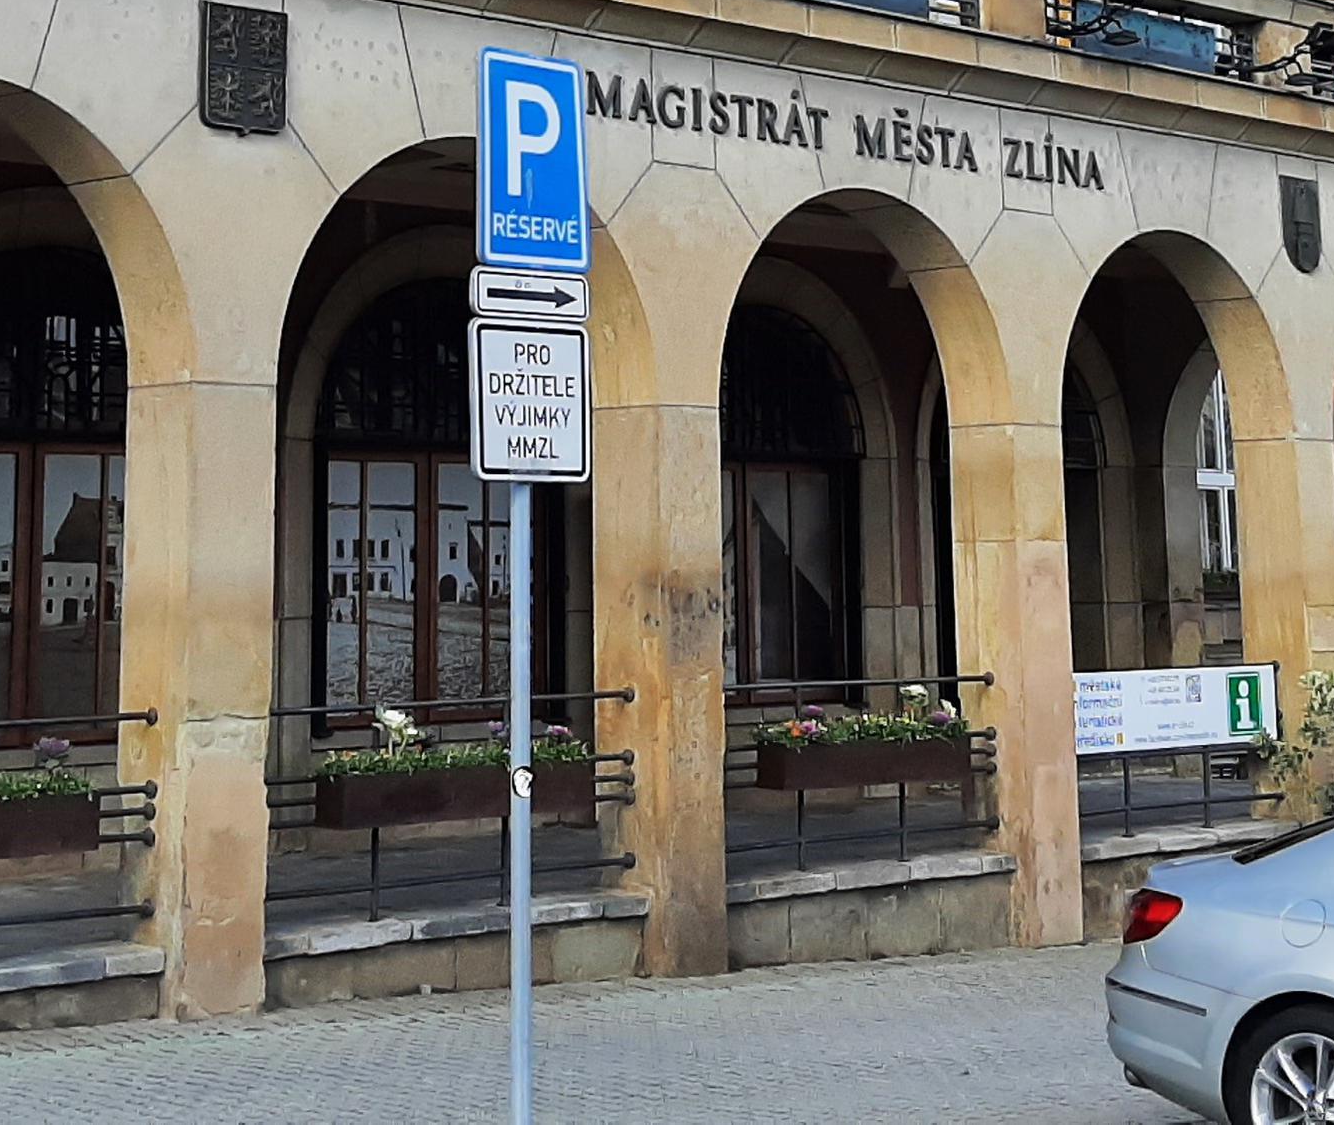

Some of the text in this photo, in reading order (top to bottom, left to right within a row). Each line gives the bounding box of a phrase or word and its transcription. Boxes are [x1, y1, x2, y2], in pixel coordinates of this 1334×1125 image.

[504, 79, 562, 197] P
[585, 70, 1106, 191] MAGISTRÁT MĚSTA ZLÍNA
[492, 208, 579, 244] RÉSERVÉ
[513, 342, 551, 365] PRO
[488, 367, 576, 398] DRŽITELE
[494, 400, 571, 428] VÝJIMKY
[507, 435, 560, 459] MMZL
